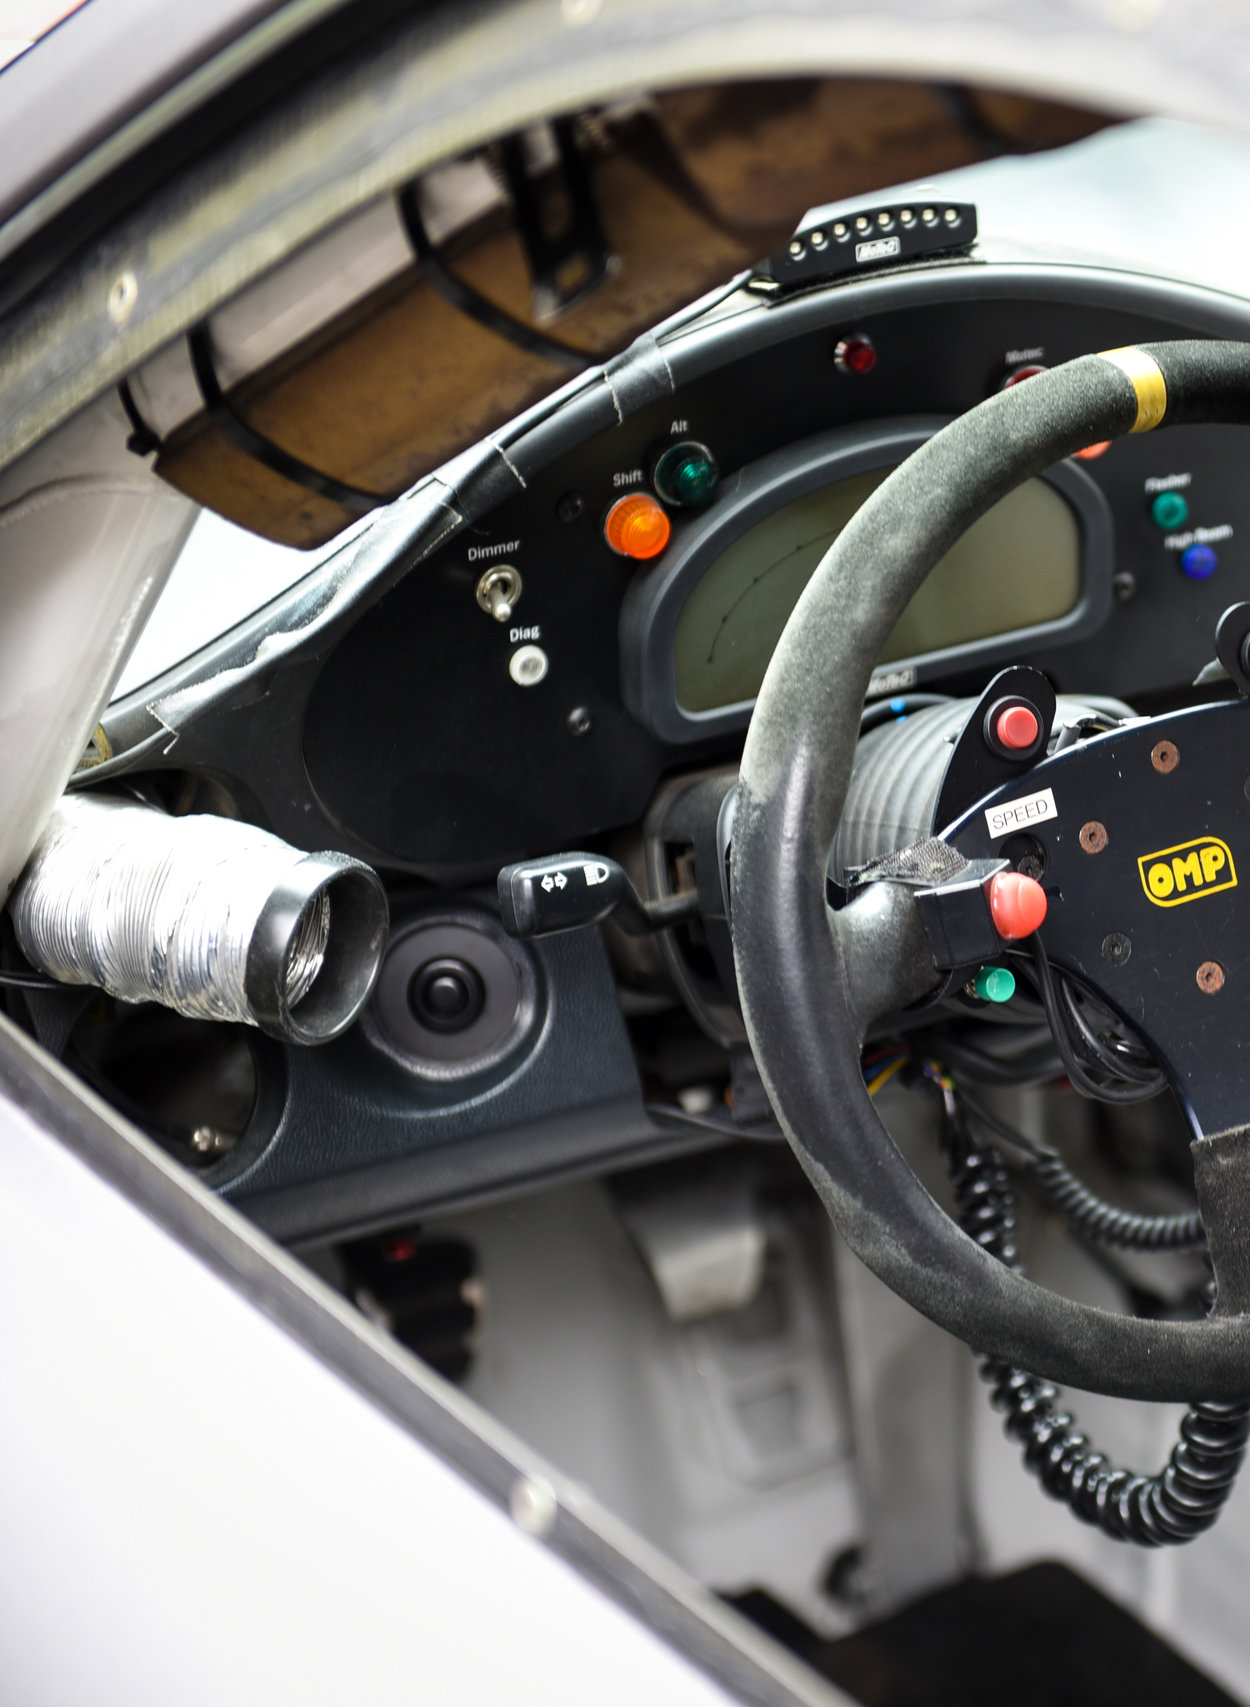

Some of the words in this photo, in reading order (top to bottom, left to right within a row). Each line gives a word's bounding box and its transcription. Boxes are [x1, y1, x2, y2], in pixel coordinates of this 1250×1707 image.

[670, 419, 688, 434] Alt
[613, 469, 642, 487] Shift
[468, 540, 520, 561] Dimmer
[509, 625, 540, 642] Diag
[992, 799, 1048, 830] SPEED
[1148, 845, 1225, 898] OMP
